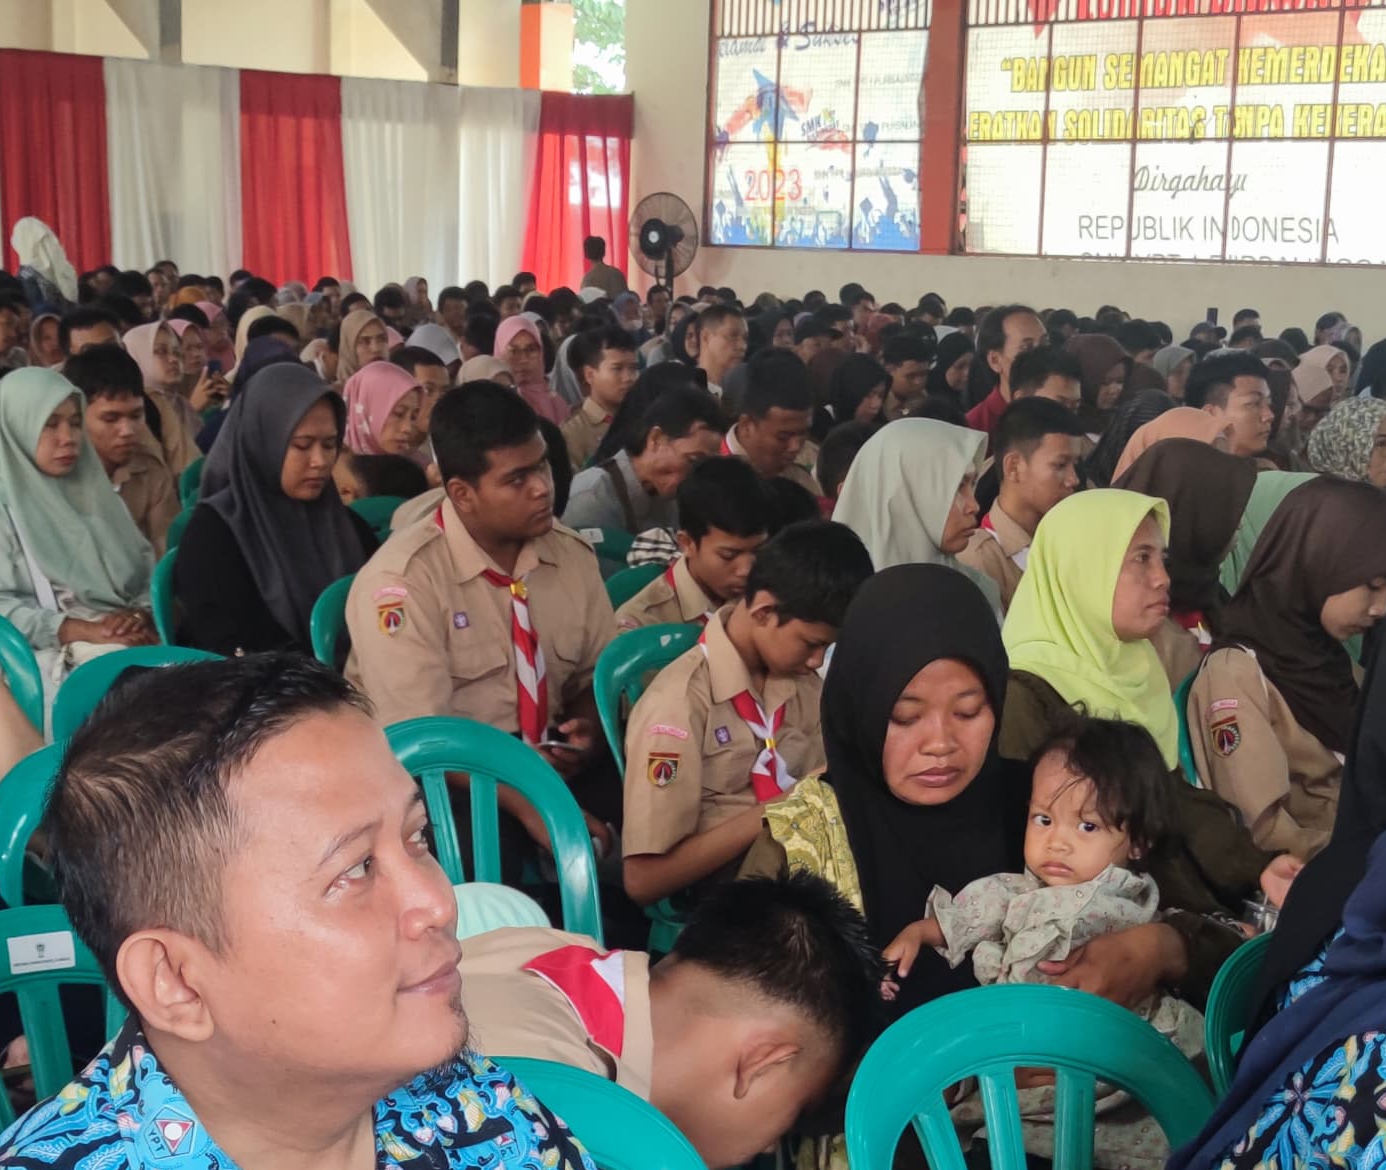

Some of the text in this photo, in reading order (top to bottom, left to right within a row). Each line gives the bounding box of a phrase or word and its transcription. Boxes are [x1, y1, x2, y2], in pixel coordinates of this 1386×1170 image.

[1103, 47, 1230, 91] SEMANGAT
[743, 168, 803, 202] 2023
[1133, 165, 1249, 200] Dirgahayu
[1078, 214, 1341, 245] REPUBLIK INDONESIA
[148, 1131, 165, 1153] YPT
